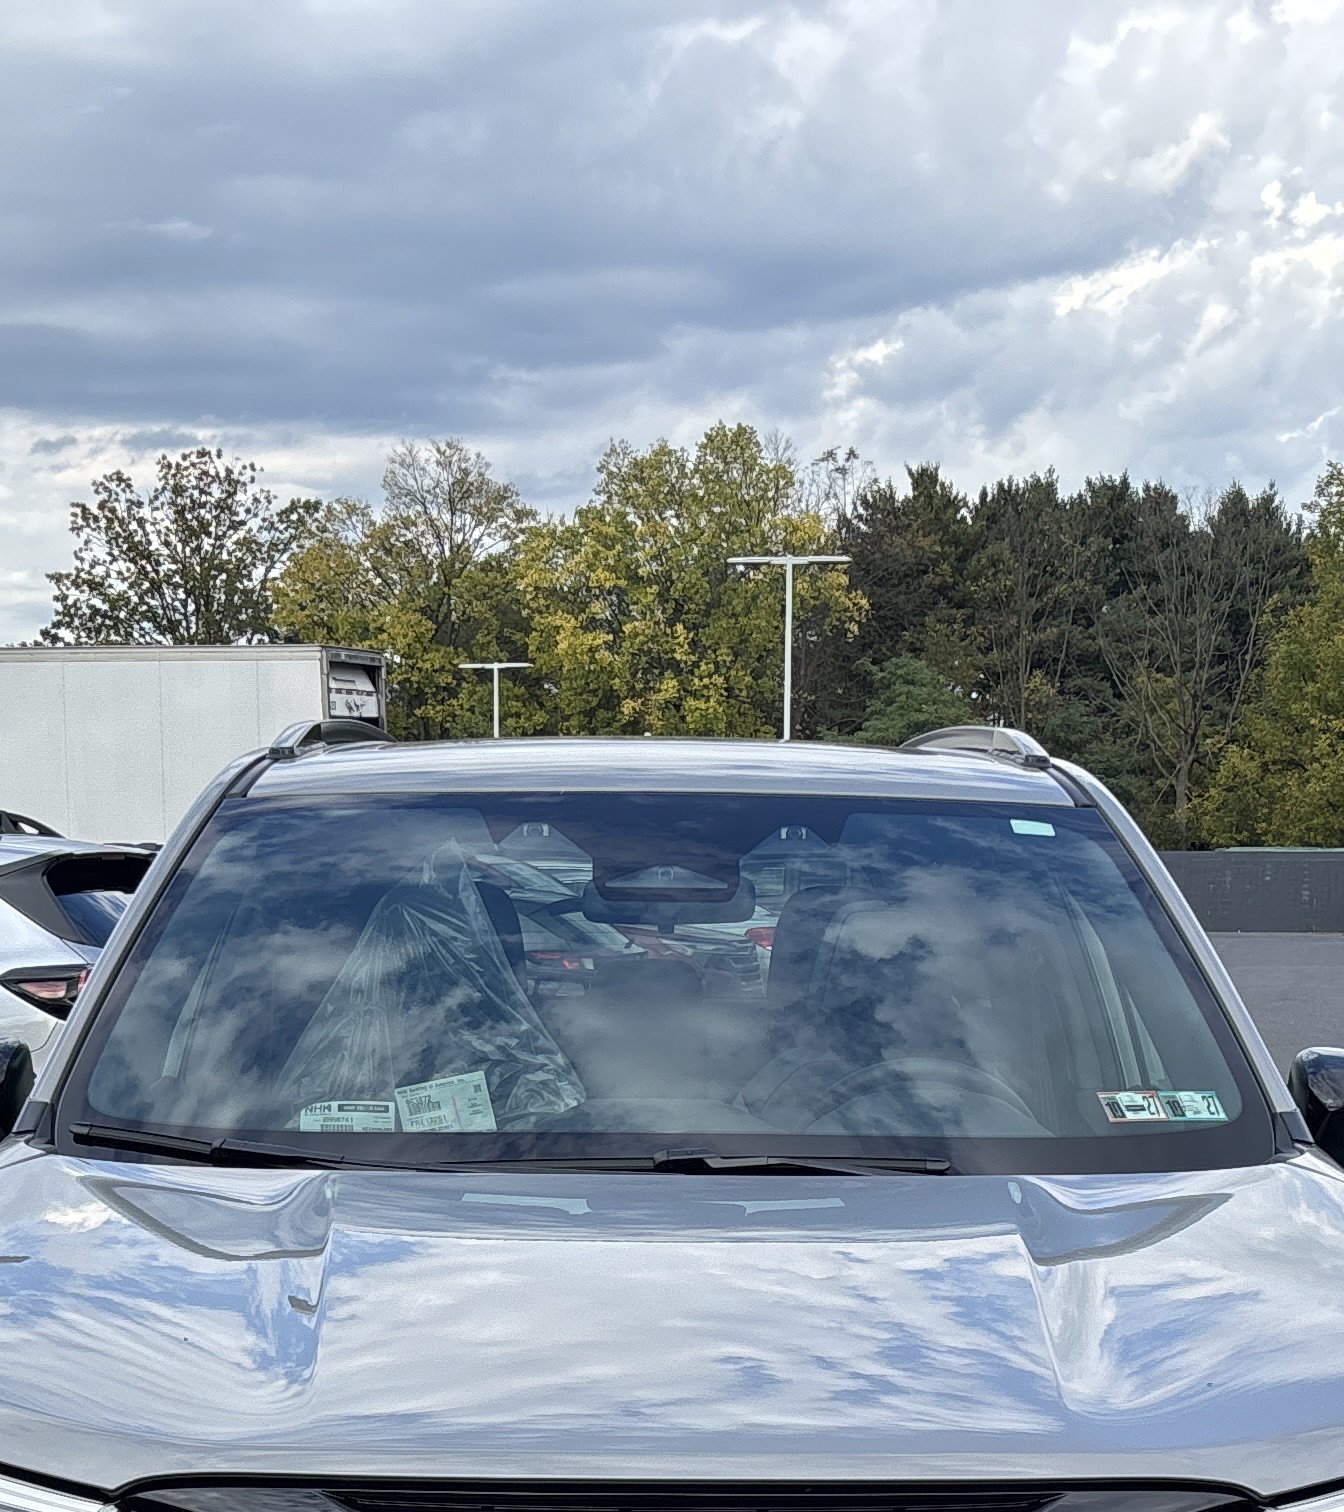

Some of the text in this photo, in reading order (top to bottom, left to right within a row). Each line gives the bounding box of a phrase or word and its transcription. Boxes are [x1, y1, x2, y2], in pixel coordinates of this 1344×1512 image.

[1105, 1101, 1128, 1119] 10
[1142, 1095, 1161, 1117] 27
[1166, 1100, 1188, 1118] 10
[1201, 1095, 1221, 1116] 27
